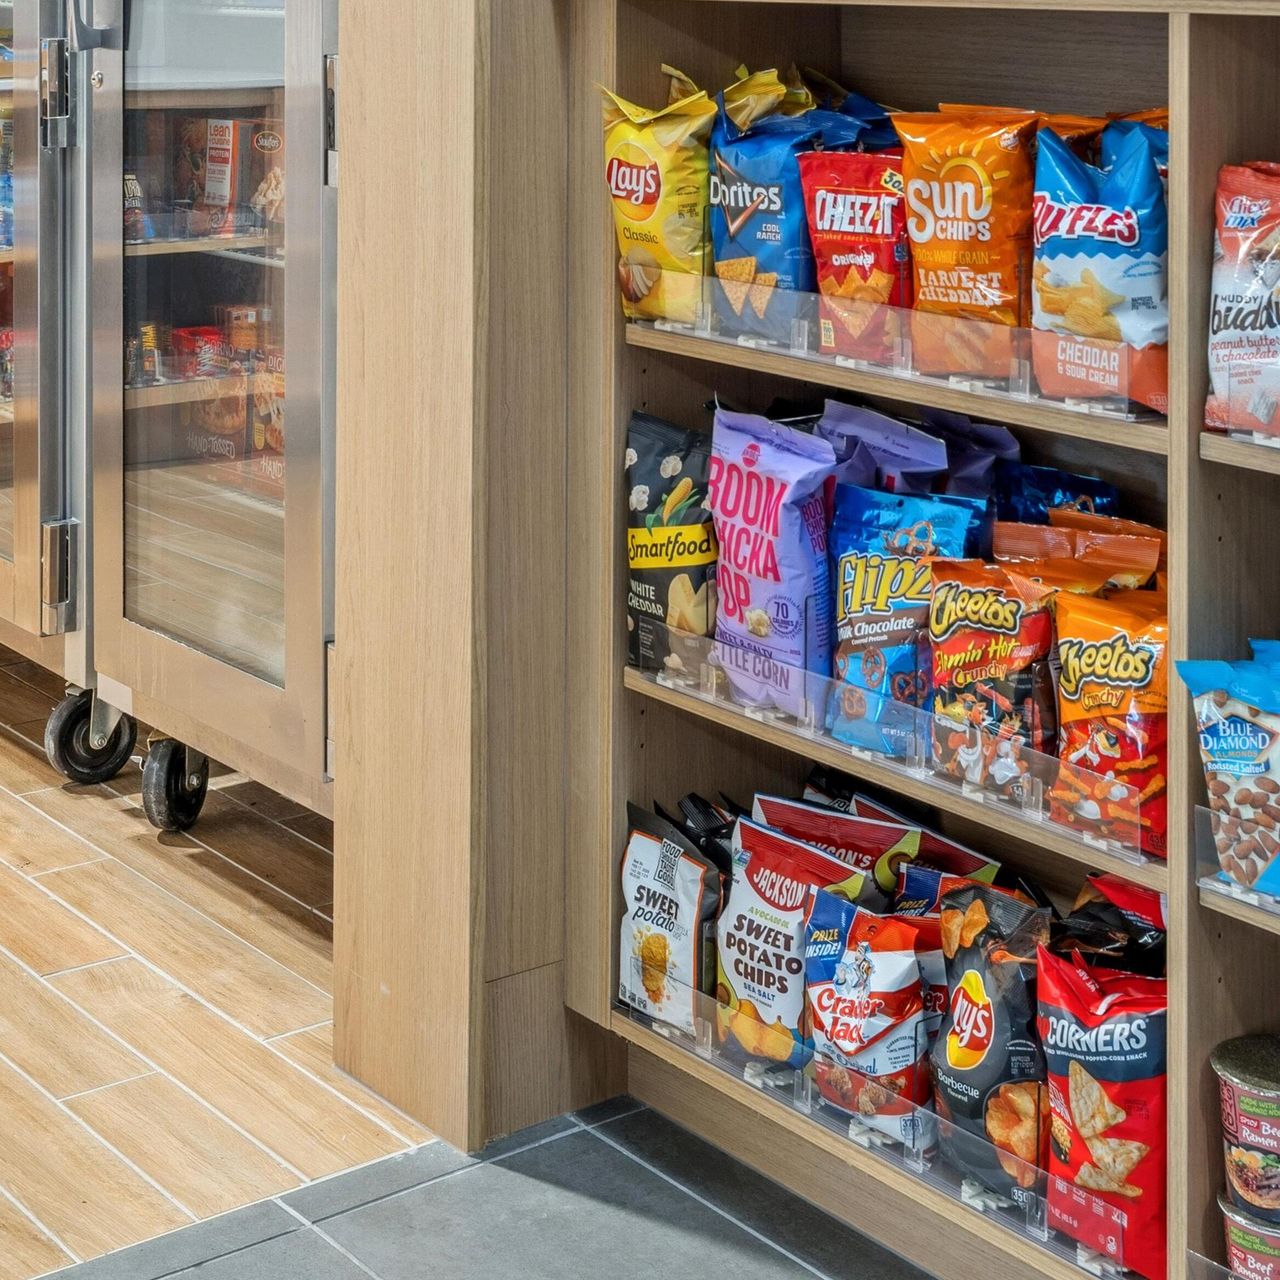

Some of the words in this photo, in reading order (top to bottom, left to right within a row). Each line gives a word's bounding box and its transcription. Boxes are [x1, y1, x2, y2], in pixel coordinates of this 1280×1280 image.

[209, 124, 231, 138] Lean
[610, 159, 657, 205] Lay's
[710, 175, 782, 211] Doritos
[907, 178, 992, 244] Sun
[622, 225, 660, 244] Classic
[756, 231, 781, 241] RANCH
[762, 223, 781, 232] COOL
[935, 220, 991, 242] CHIPS
[934, 250, 957, 264] WHOLE
[959, 251, 990, 265] GRAIN
[1220, 294, 1260, 304] MUDDY
[1057, 339, 1120, 372] CHEDDAR
[1065, 366, 1086, 380] SOUR
[1089, 370, 1120, 387] CREAM
[708, 455, 789, 538] BOOM
[629, 532, 711, 562] Smartfood
[630, 578, 656, 600] WHITE
[628, 594, 664, 617] CHEDDAR
[774, 601, 789, 619] 70
[930, 582, 1019, 639] Cheetos
[854, 616, 914, 637] Chocolate
[989, 633, 1019, 660] Hot
[753, 655, 790, 691] CORN
[952, 661, 1007, 687] Crunchy
[1220, 720, 1254, 736] BLUE
[1200, 732, 1270, 751] DIAMOND
[1207, 761, 1239, 772] Roasted
[1240, 762, 1266, 773] Salted
[663, 841, 681, 858] FOOD
[634, 884, 680, 920] SWEET
[896, 898, 929, 910] PRIZE
[632, 905, 675, 932] potato
[733, 913, 794, 952] SWEET
[810, 927, 839, 943] PRIZE
[725, 931, 803, 975] POTATO
[733, 957, 789, 994] CHIPS
[743, 982, 757, 996] SEA
[757, 988, 776, 1002] SALT
[1126, 1052, 1148, 1062] SNACK
[937, 1067, 980, 1099] Barbecue
[1242, 1126, 1278, 1148] Ramen
[1246, 1251, 1274, 1276] Beef
